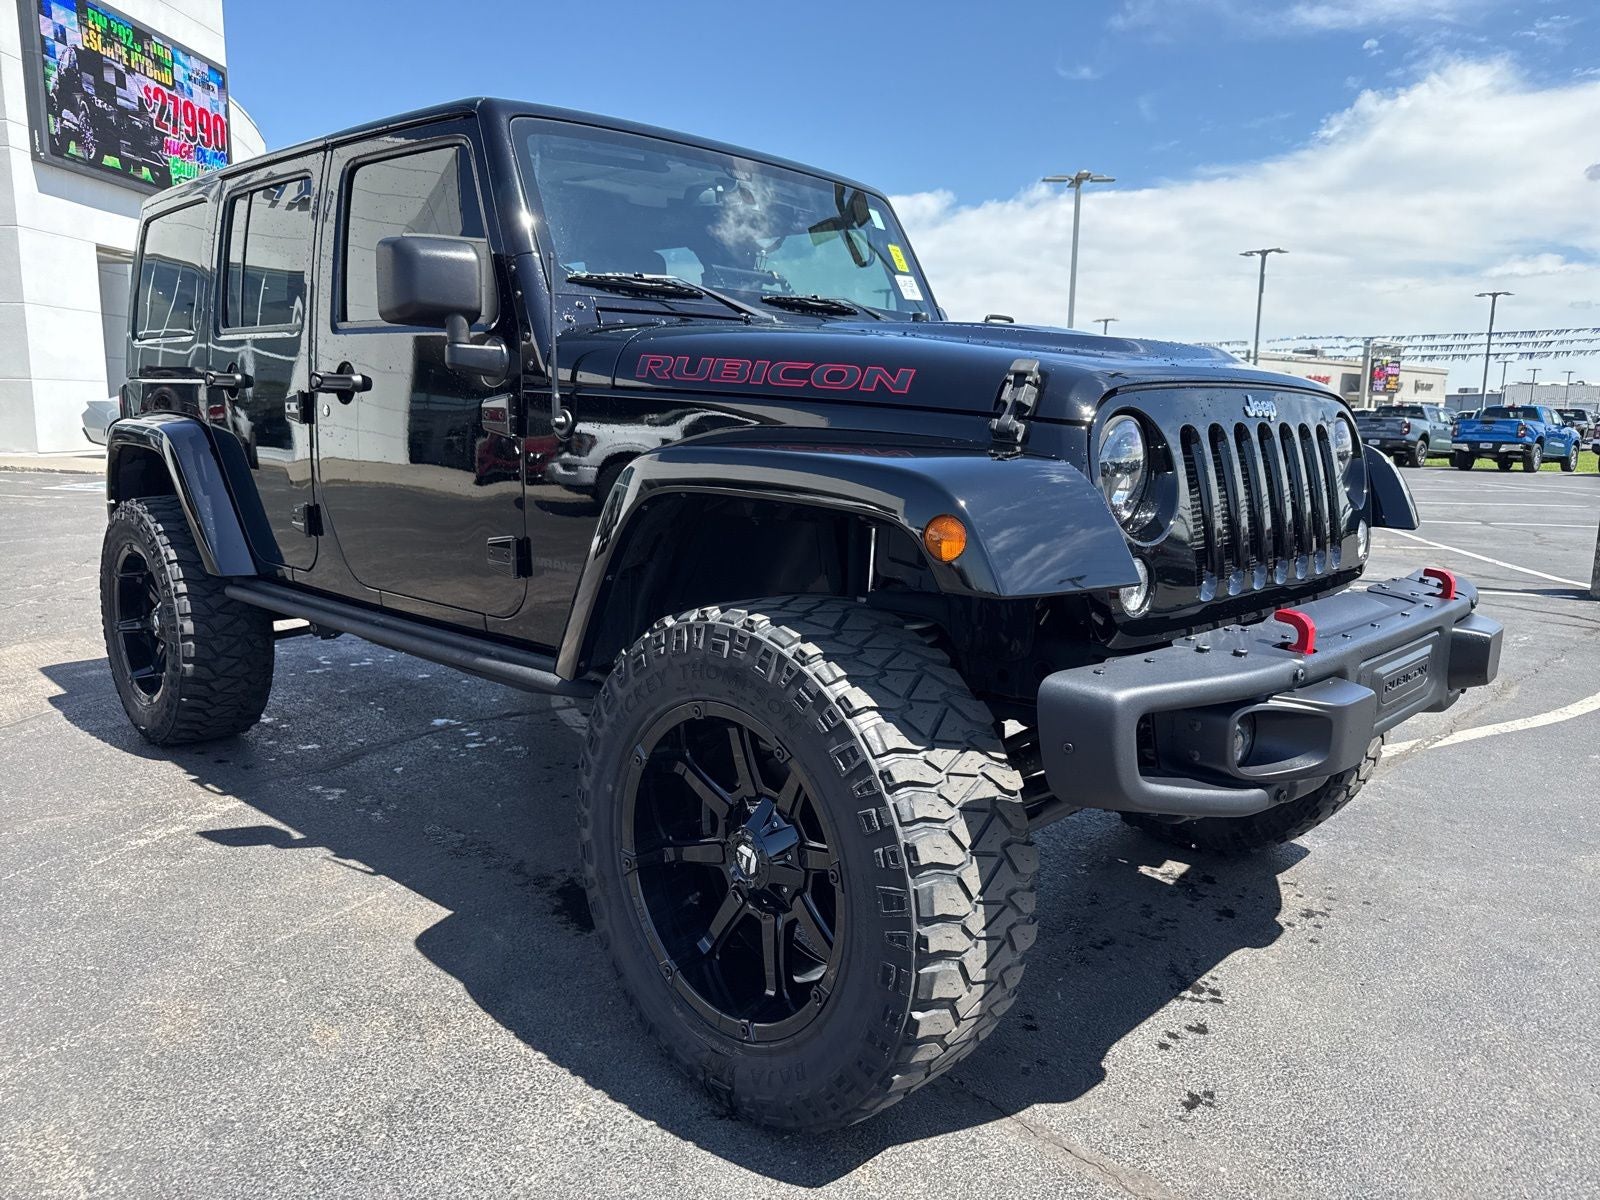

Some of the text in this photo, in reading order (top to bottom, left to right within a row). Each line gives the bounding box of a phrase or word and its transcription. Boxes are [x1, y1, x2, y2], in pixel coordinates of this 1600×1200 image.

[163, 136, 194, 161] HUGE
[635, 353, 916, 394] RUBICON
[1243, 394, 1277, 422] Jeep
[1384, 664, 1428, 692] RUBICON
